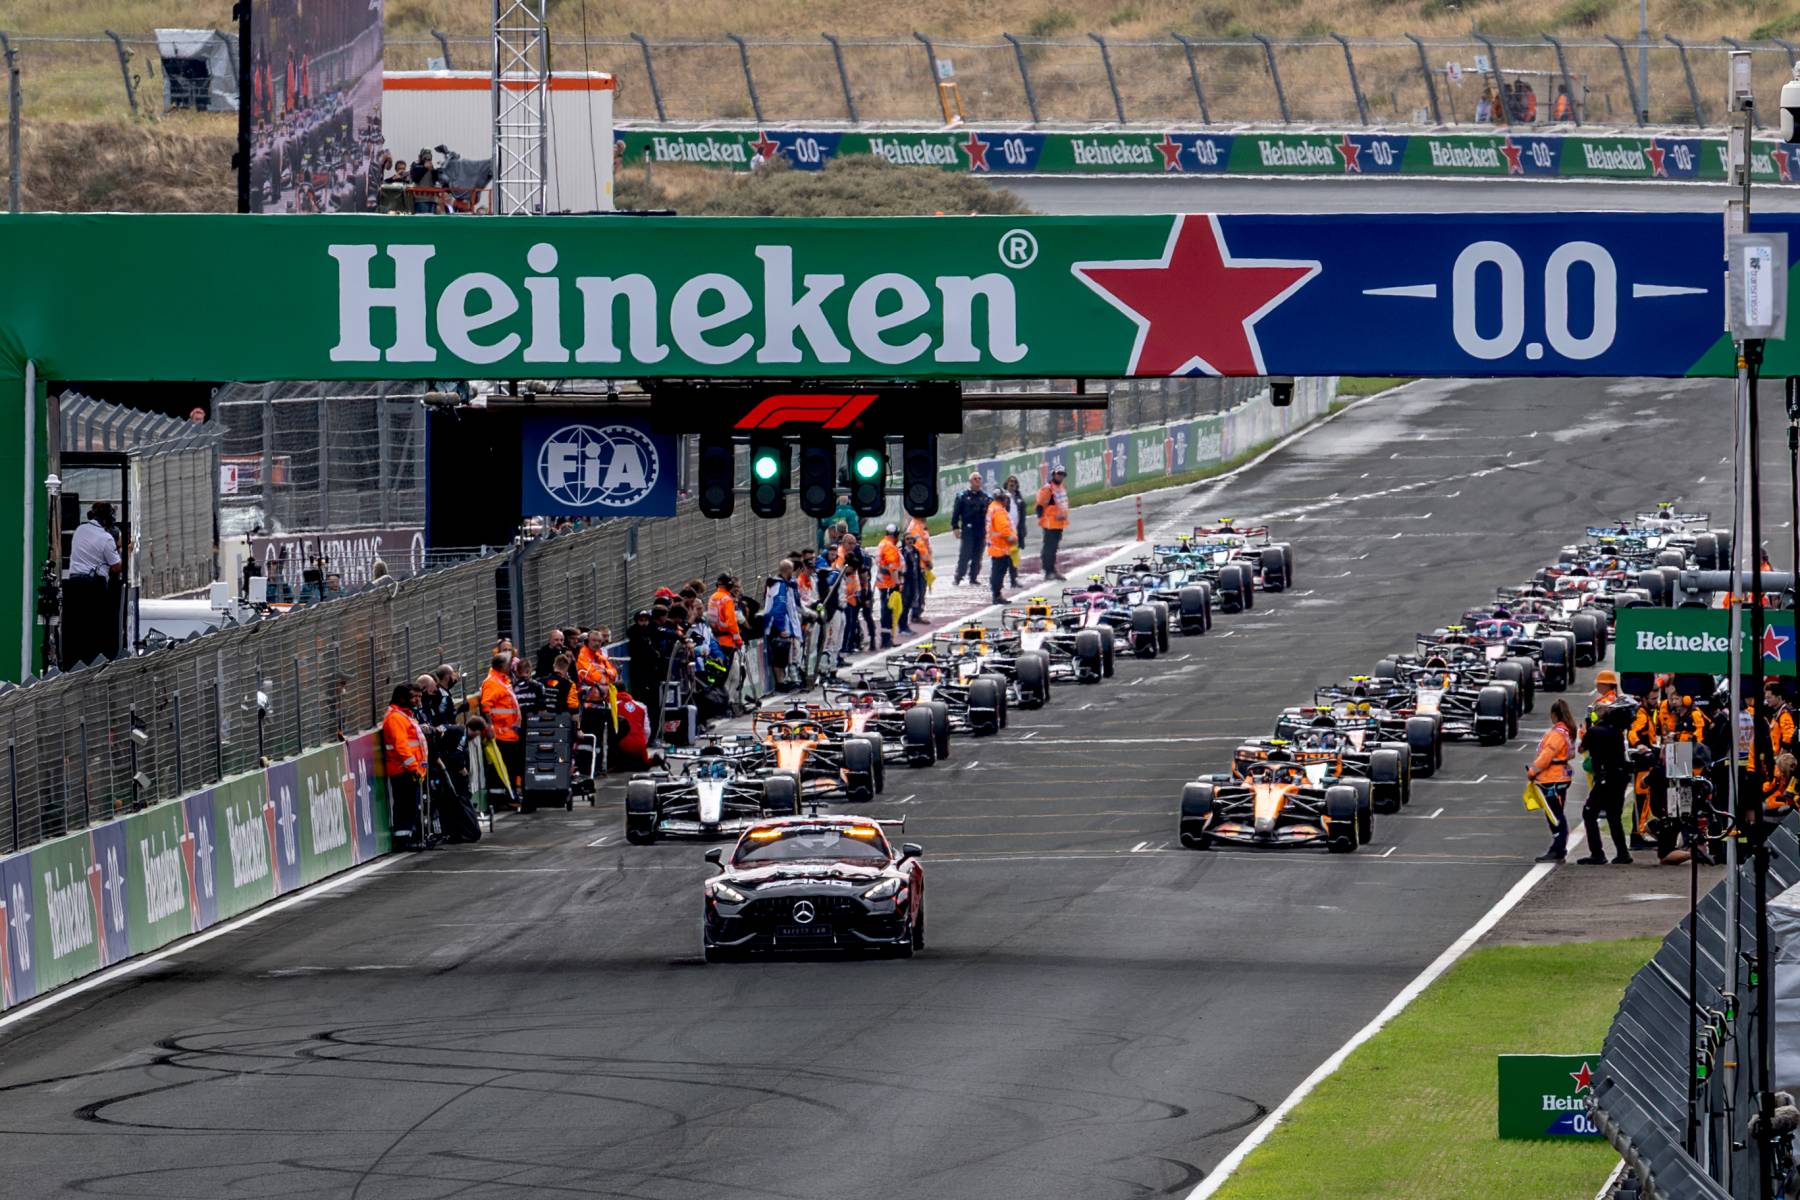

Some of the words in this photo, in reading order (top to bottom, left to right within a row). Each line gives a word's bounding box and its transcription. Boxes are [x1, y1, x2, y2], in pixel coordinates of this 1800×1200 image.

[653, 137, 747, 162] Heineken
[869, 138, 959, 164] Heineken
[1071, 139, 1154, 165] Heineken
[1258, 140, 1336, 166] Heineken
[1429, 141, 1500, 167] Heineken
[1583, 143, 1647, 170] Heineken
[1453, 240, 1617, 360] 0.0
